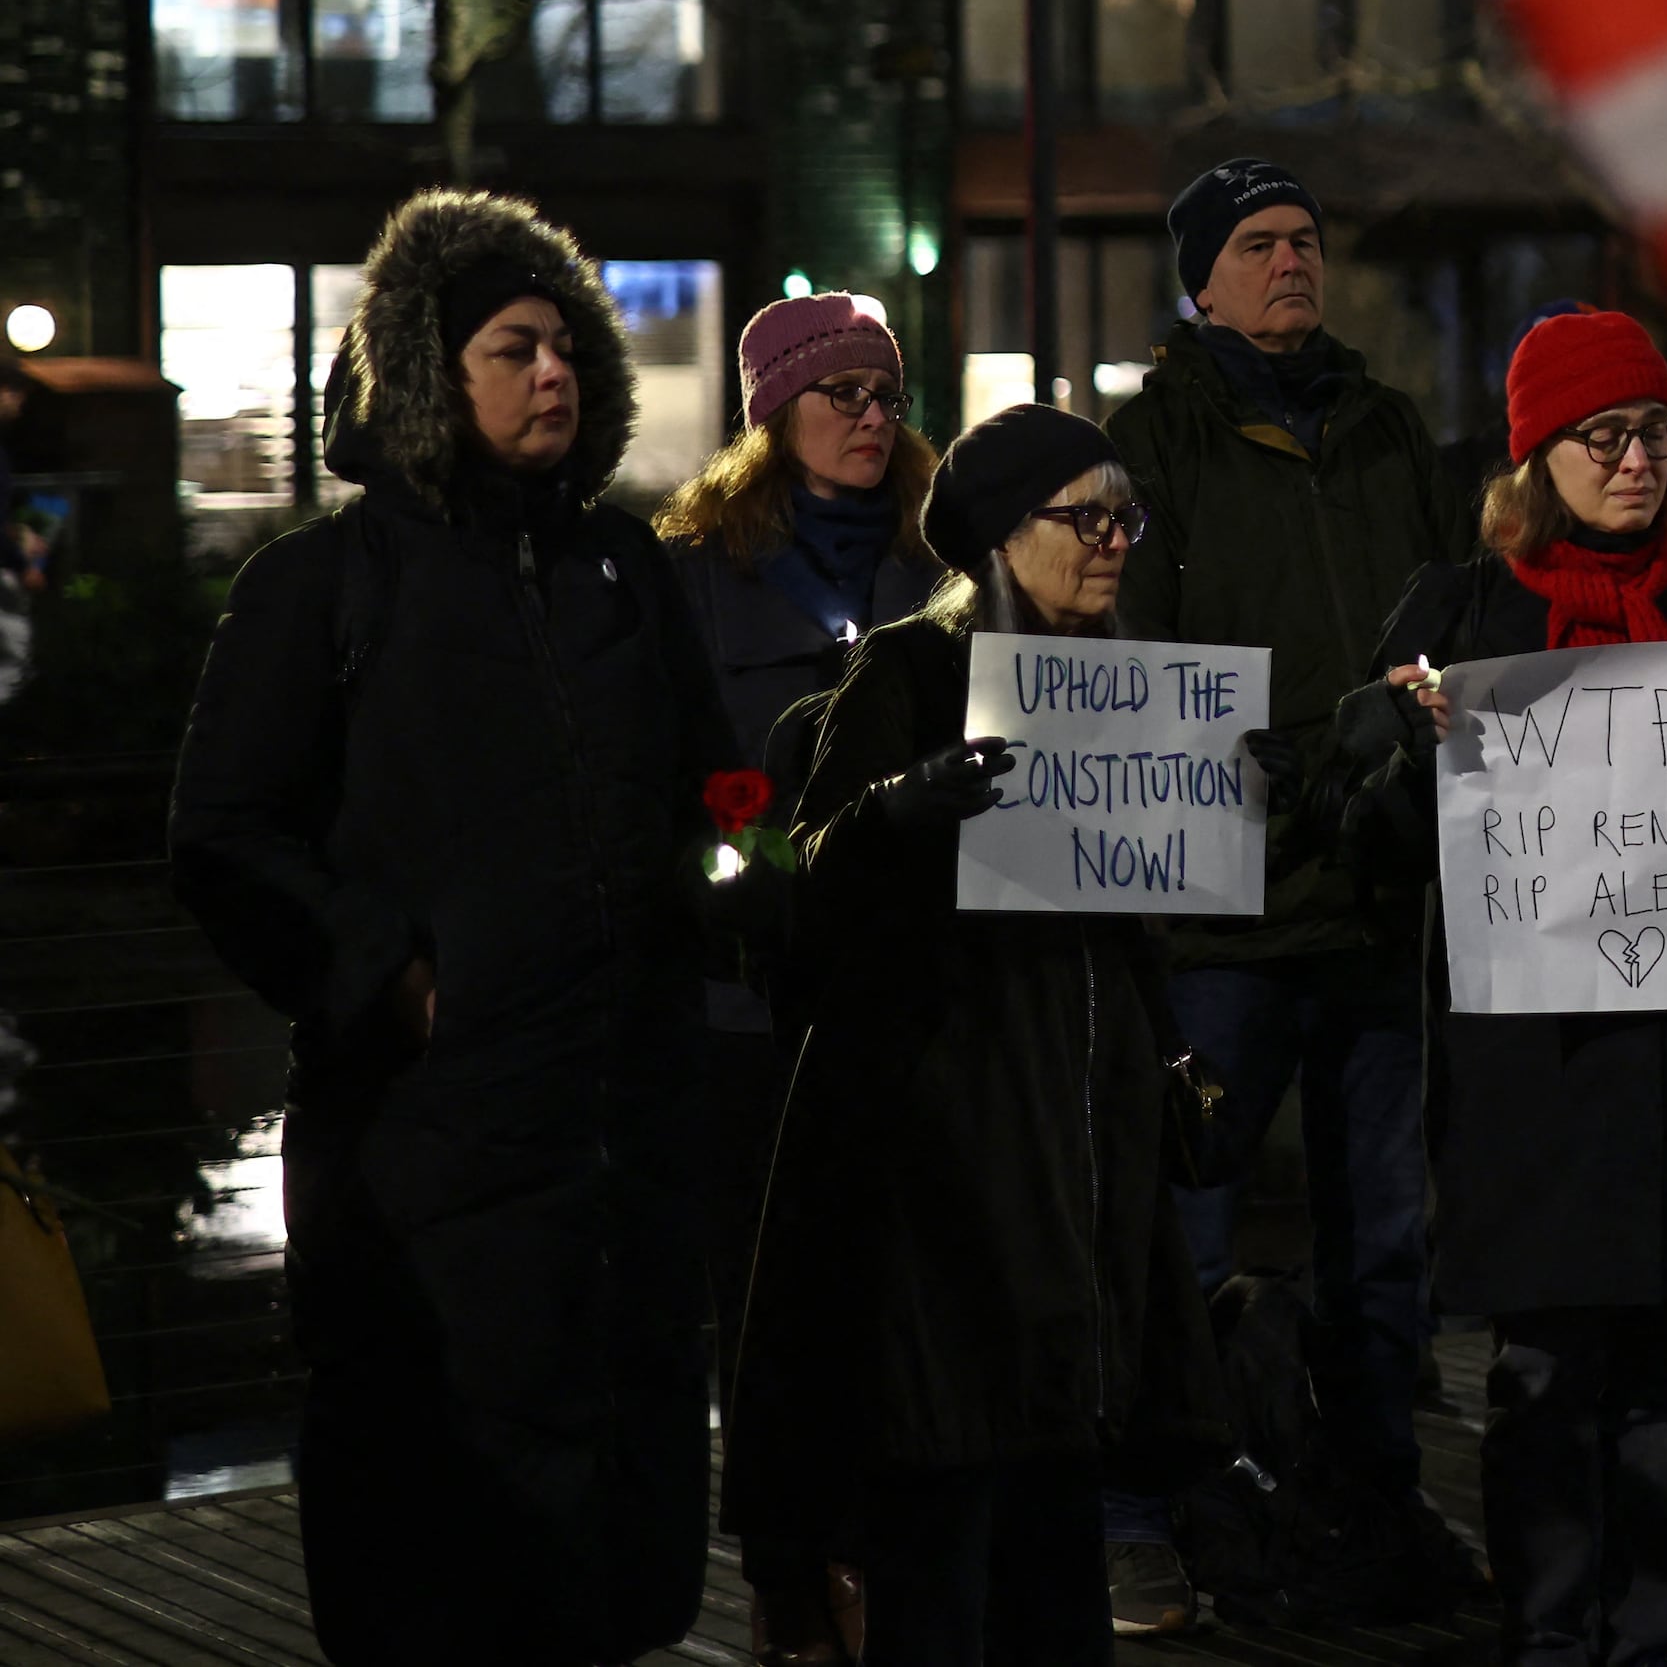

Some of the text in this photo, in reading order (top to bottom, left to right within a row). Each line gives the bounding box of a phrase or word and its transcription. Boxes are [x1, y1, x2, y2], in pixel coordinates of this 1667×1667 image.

[1016, 652, 1239, 722] UPHOLD THE
[1071, 826, 1186, 893] NOW!
[1483, 805, 1556, 856] RIP
[1483, 873, 1548, 925] RIP
